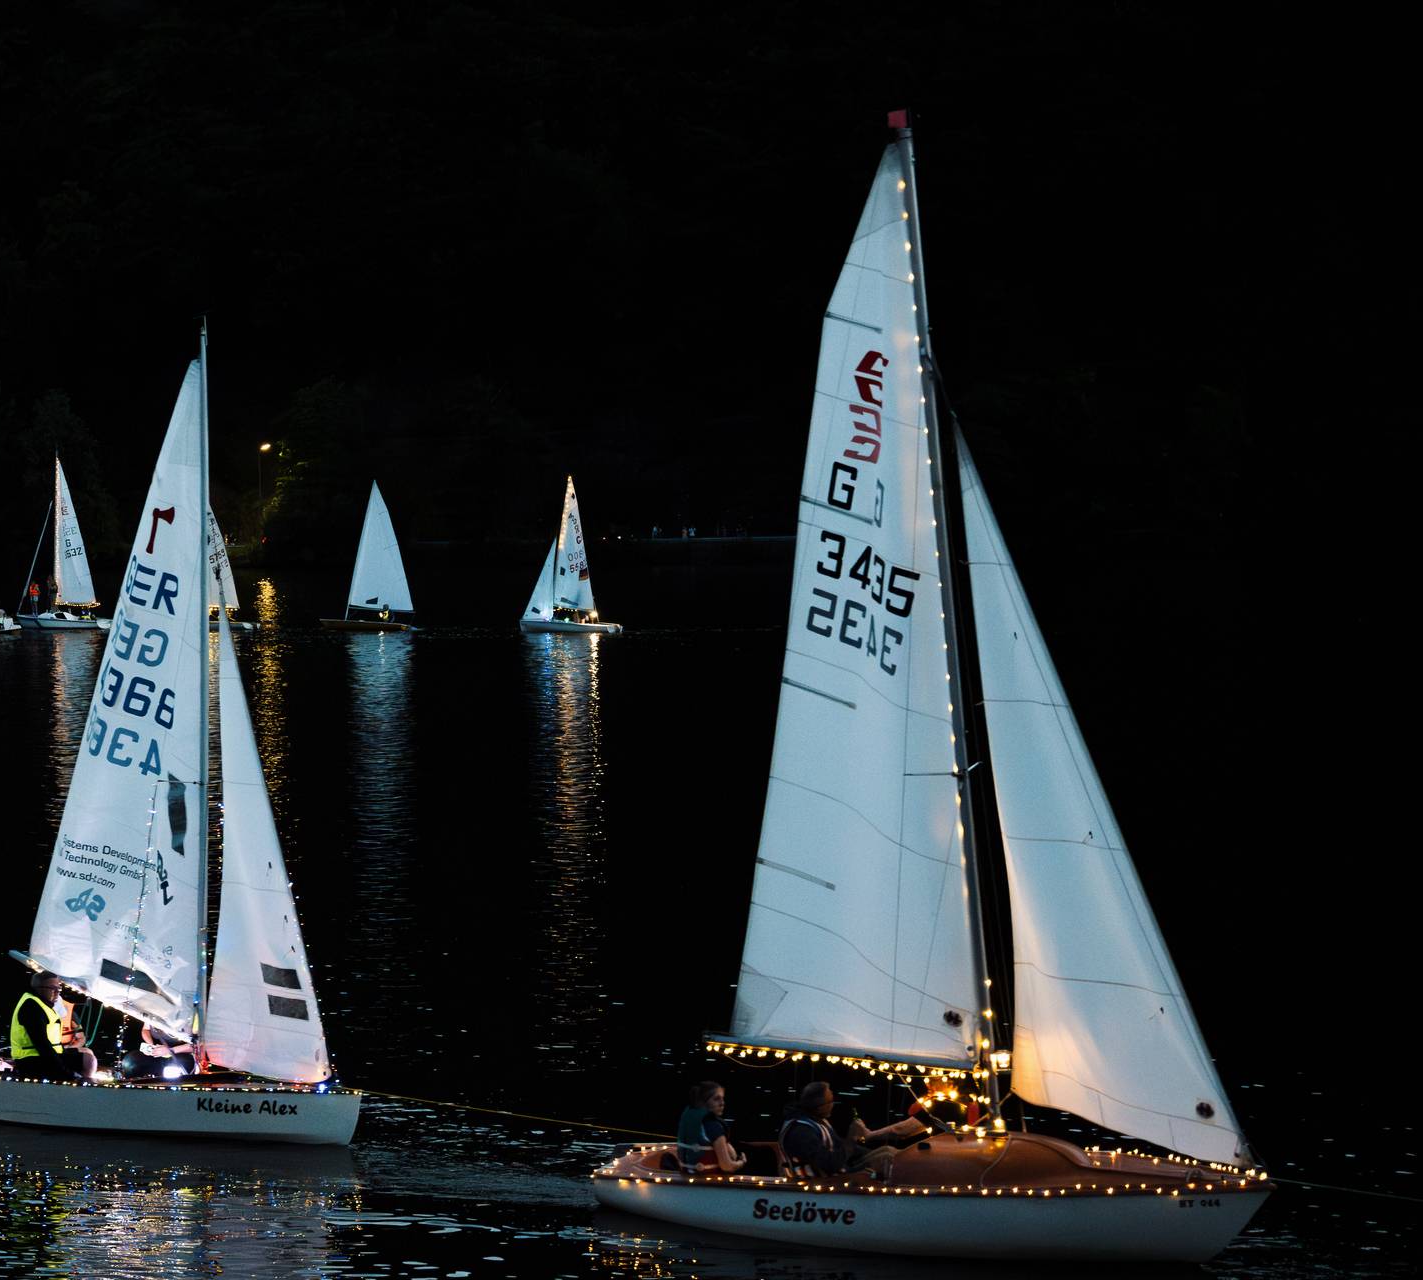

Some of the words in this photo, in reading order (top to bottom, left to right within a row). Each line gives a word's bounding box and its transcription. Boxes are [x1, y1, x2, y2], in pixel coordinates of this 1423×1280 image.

[827, 461, 858, 511] G
[816, 529, 921, 618] 3435
[64, 850, 118, 874] Technology
[196, 1097, 252, 1114] Kleine
[259, 1100, 298, 1116] Alex
[752, 1198, 856, 1225] Seelöwe
